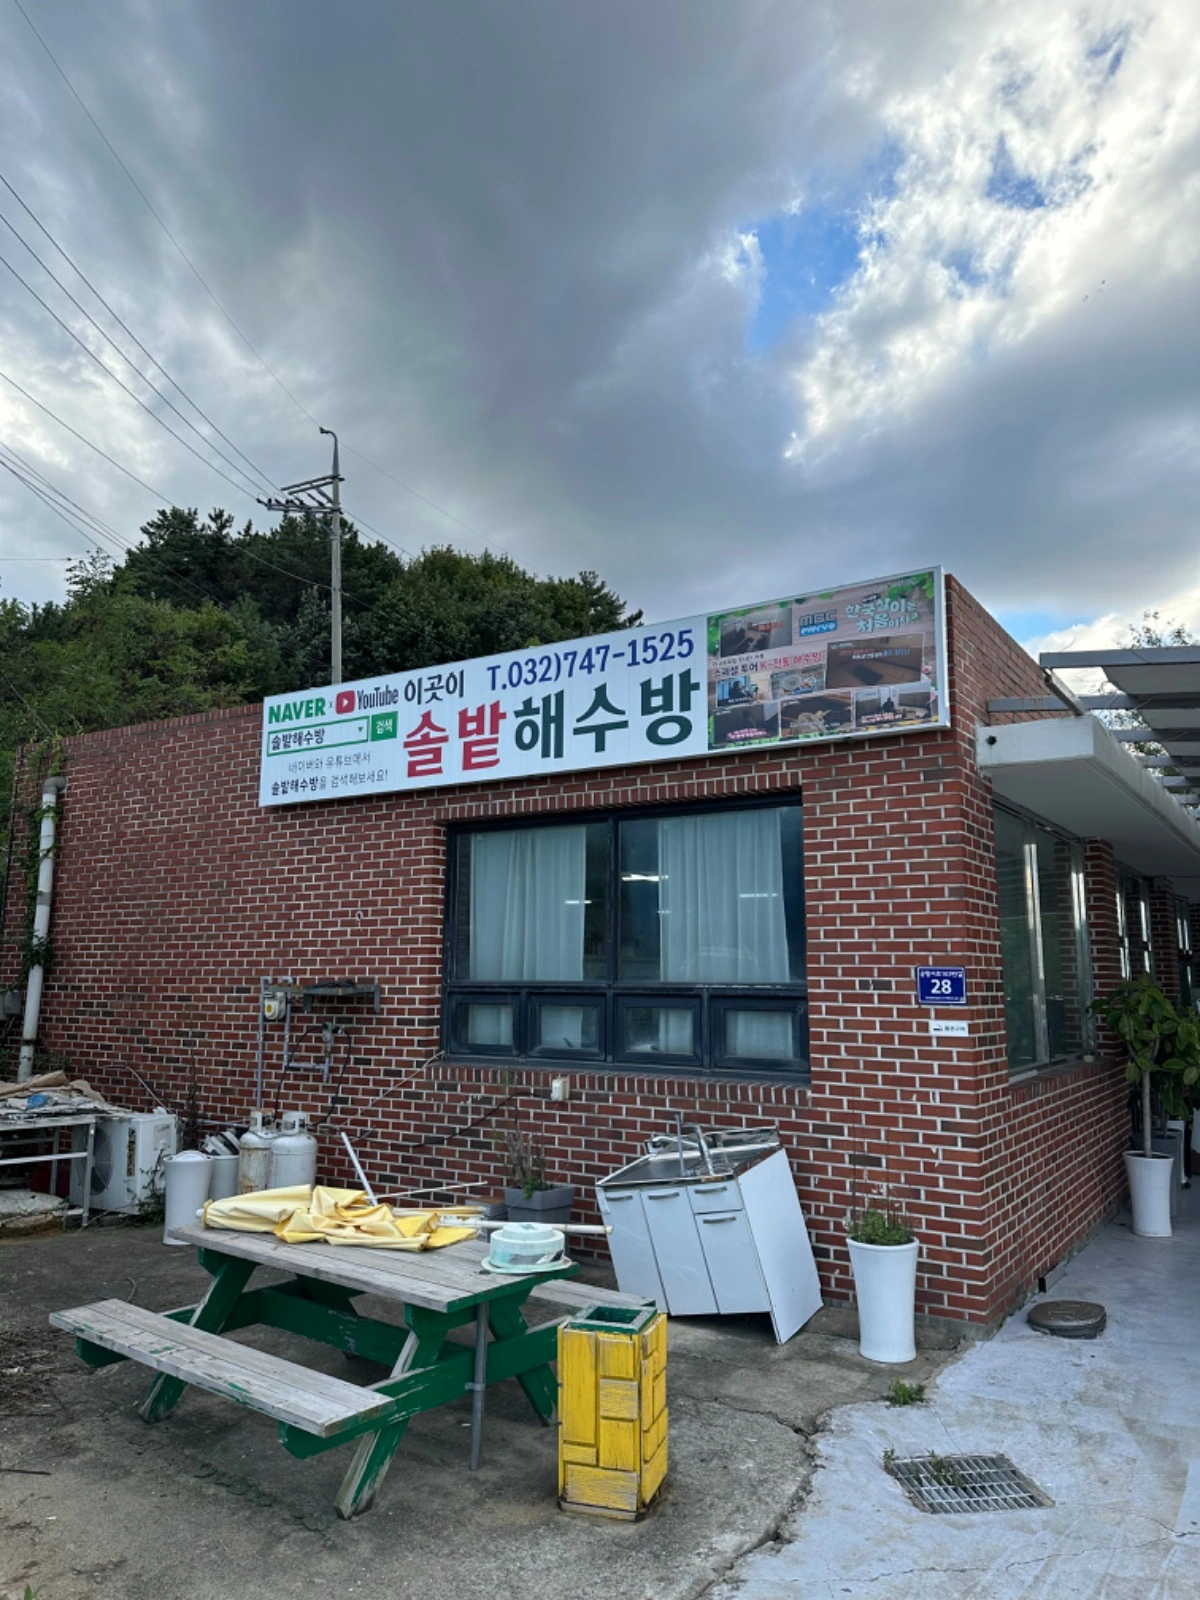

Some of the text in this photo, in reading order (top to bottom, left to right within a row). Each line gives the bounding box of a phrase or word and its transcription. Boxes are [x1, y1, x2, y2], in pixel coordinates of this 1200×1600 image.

[801, 609, 837, 626] MBC
[487, 628, 694, 691] T.032)747-1525
[404, 669, 465, 705] 이곳이
[268, 697, 326, 724] NAVER
[357, 684, 399, 710] YouTube
[376, 718, 394, 735] 검색
[403, 667, 700, 778] 솔밭해수방
[271, 728, 325, 750] 솔밭해수방
[288, 751, 371, 773] 네이버와 유튜브에서
[271, 769, 388, 796] 솔밭해수방을 검색해보세요!
[931, 979, 952, 994] 28
